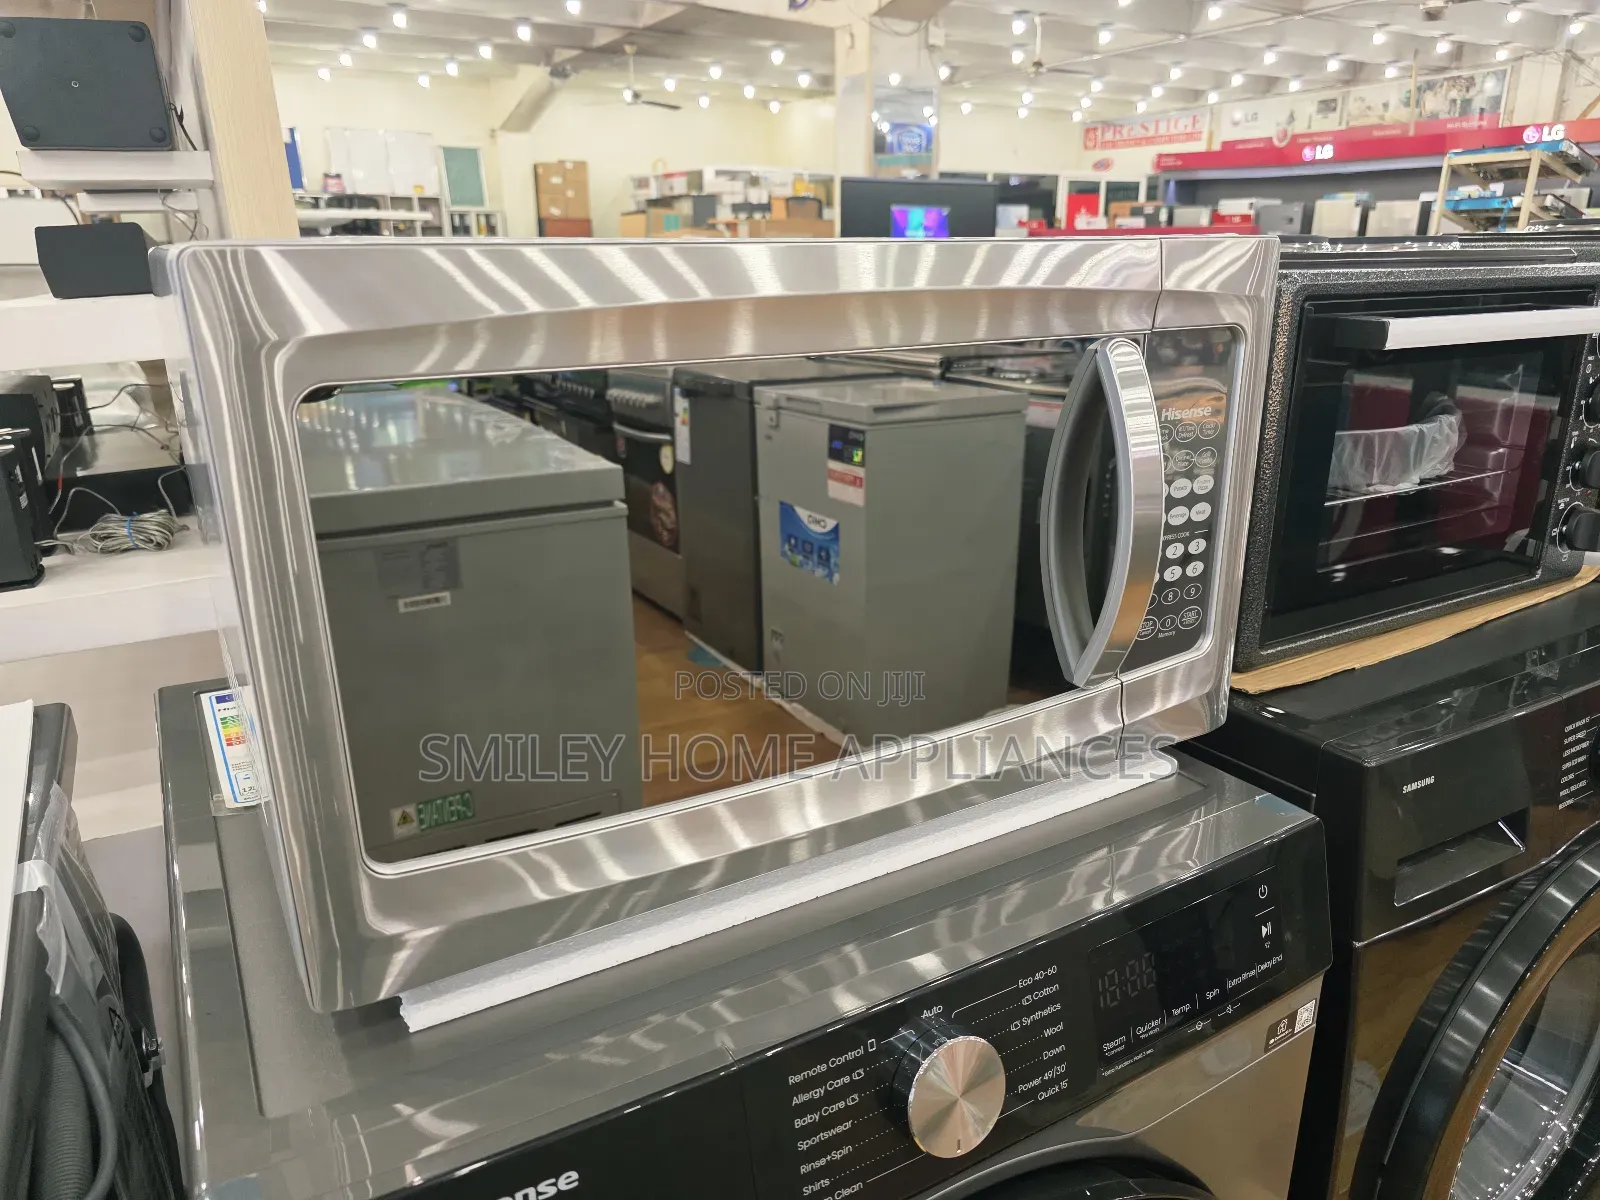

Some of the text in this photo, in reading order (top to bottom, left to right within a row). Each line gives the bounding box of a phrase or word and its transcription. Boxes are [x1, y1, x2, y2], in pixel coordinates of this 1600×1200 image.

[1100, 114, 1200, 140] PRESTIGE
[1542, 124, 1566, 142] LG
[1315, 144, 1334, 160] LG
[1161, 406, 1212, 422] Hisense
[1172, 546, 1178, 556] 2
[1194, 541, 1200, 552] 3
[1170, 568, 1176, 579] 5
[1192, 563, 1198, 574] 6
[1168, 591, 1174, 602] 8
[1190, 587, 1196, 598] 9
[1183, 610, 1198, 618] START
[1165, 618, 1171, 628] 0
[1402, 776, 1434, 794] SAMSUNG
[1258, 954, 1283, 973] Delay End
[1018, 964, 1058, 989] Eco 40-60
[1228, 969, 1256, 988] Extra Rinse
[1032, 983, 1060, 1000] Cotton
[1206, 988, 1220, 1000] Spin
[920, 1006, 943, 1019] Auto
[1022, 1002, 1062, 1027] Synthetics
[1172, 1003, 1192, 1016] Temp.
[1044, 1022, 1064, 1038] Wool
[1136, 1018, 1162, 1034] Quicker
[1043, 1043, 1066, 1060] Down
[1102, 1036, 1126, 1052] Steam
[788, 1048, 864, 1086] Remote Control
[792, 1074, 850, 1106] Allergy Care
[1018, 1076, 1042, 1094] Power
[1038, 1084, 1060, 1100] Quick
[794, 1099, 846, 1128] Baby Care
[797, 1120, 852, 1151] Sportswear
[800, 1144, 852, 1174] Rinse+Spin
[802, 1178, 830, 1196] Shirts
[834, 1181, 864, 1200] Clean
